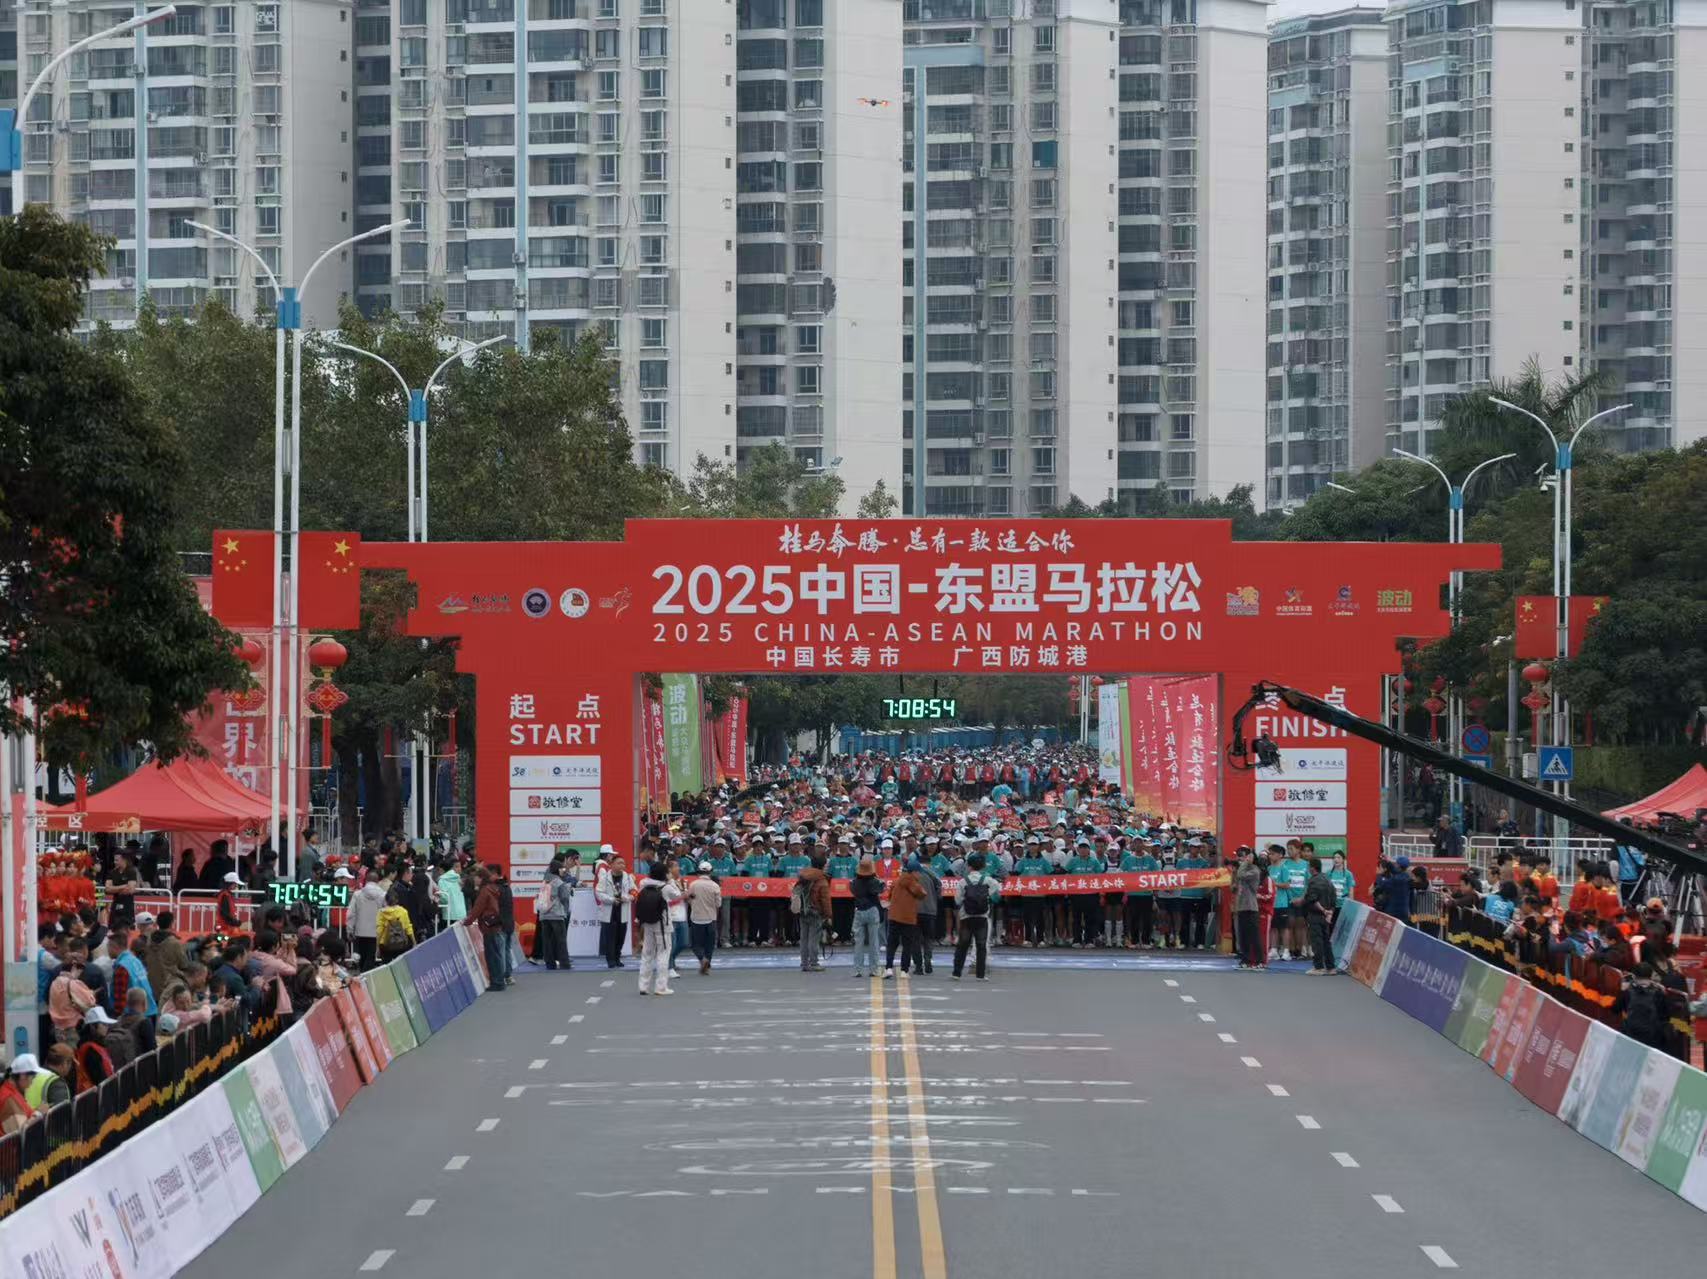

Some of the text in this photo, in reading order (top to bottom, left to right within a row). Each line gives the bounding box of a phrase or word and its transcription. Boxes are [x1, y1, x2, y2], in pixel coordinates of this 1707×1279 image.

[651, 562, 1202, 615] 2025中国-东盟马拉松
[653, 621, 1203, 643] 2025 CHINA-ASEAN MARATHON
[766, 644, 1088, 668] 中国长寿市 广西防城港
[509, 693, 601, 719] 起点
[883, 698, 955, 718] 7:08:54
[509, 723, 602, 745] START
[1138, 872, 1188, 889] START
